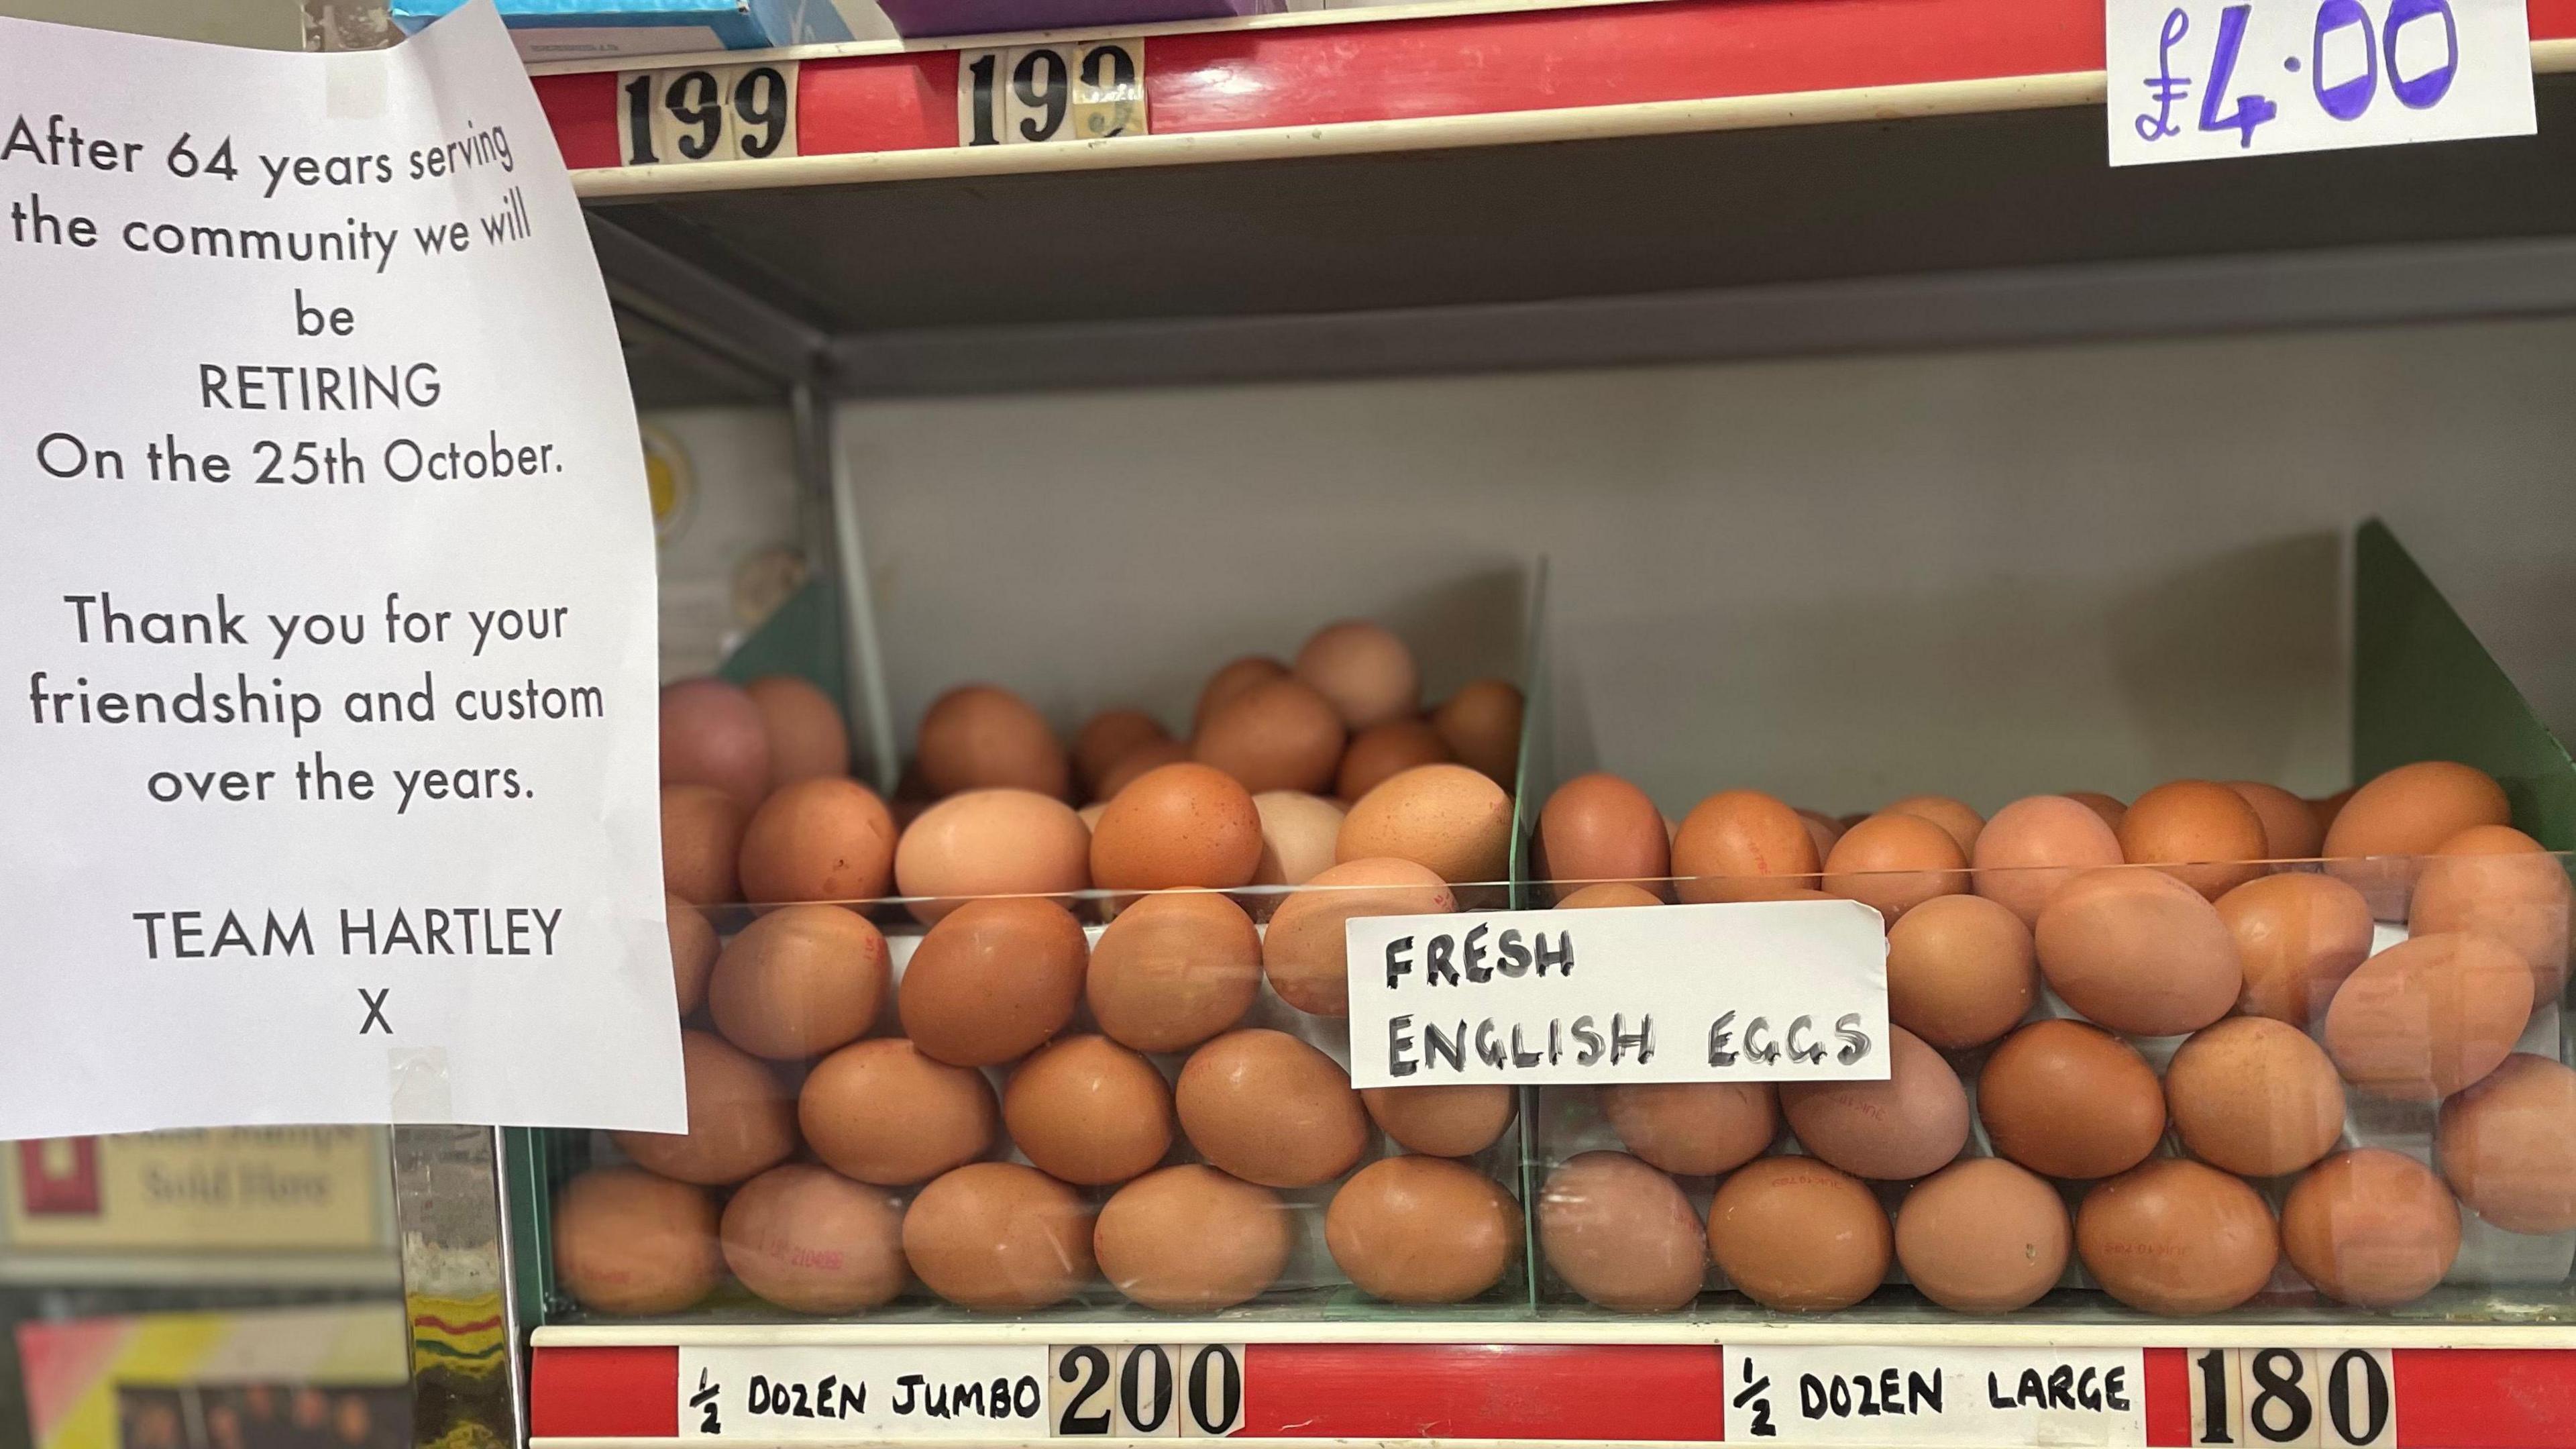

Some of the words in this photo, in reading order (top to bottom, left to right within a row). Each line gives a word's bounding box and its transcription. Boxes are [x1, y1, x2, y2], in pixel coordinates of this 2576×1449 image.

[625, 68, 788, 165] 199
[0, 115, 143, 172] After
[168, 132, 237, 180] 64
[259, 155, 392, 198] years
[411, 120, 513, 180] serving
[11, 193, 97, 247] the
[123, 218, 398, 273] community
[414, 223, 469, 255] we
[480, 186, 531, 245] will
[294, 288, 354, 336] be
[200, 363, 439, 410] RETIRING
[37, 433, 123, 479] On
[148, 434, 231, 482] the
[253, 437, 364, 484] 25th
[384, 430, 561, 482] October.
[64, 592, 248, 643] Thank
[268, 615, 364, 659] you
[386, 592, 451, 643] for
[468, 607, 568, 656] your
[30, 672, 321, 737] friendship
[345, 671, 434, 722] and
[456, 679, 603, 720] custom
[148, 771, 275, 802] over
[296, 751, 374, 800] the
[393, 769, 533, 814] years.
[133, 908, 314, 959] TEAM
[341, 907, 562, 955] HARTLEY
[1386, 922, 1574, 989] FRESH
[358, 989, 393, 1034] X
[1389, 1013, 1654, 1077] ENGLISH
[1708, 1010, 1871, 1067] EGGS
[749, 1375, 866, 1419] DOZEN
[893, 1375, 1040, 1419] JUMBO
[1059, 1344, 1241, 1436] 200
[1800, 1368, 1942, 1419] DOZEN
[1988, 1364, 2130, 1412] LARGE
[2197, 1348, 2389, 1445] 180
